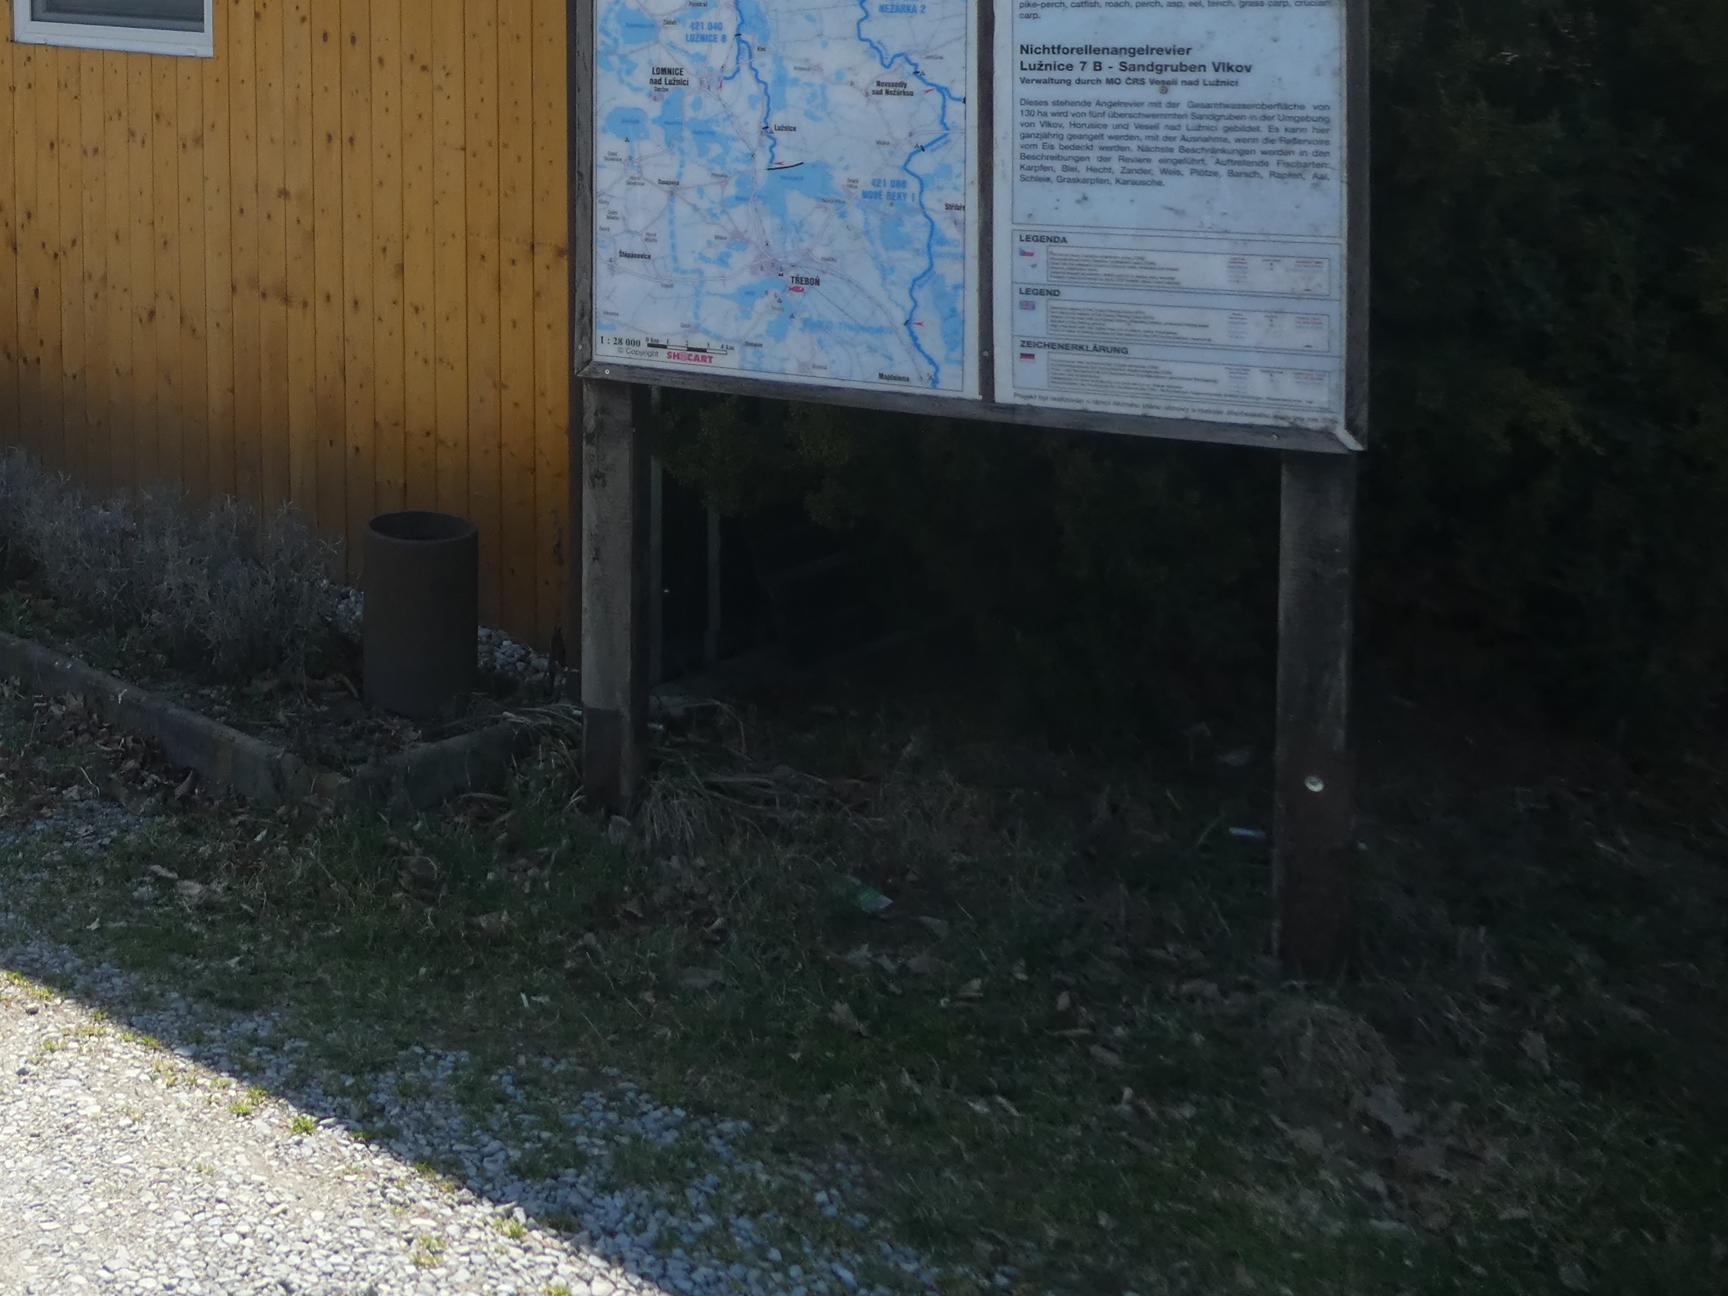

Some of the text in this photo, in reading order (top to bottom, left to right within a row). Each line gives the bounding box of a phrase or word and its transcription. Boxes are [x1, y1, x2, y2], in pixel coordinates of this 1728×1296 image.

[1020, 44, 1191, 56] Nichtforellenangelrevier
[651, 67, 684, 75] LOMNICE
[1020, 59, 1073, 71] Lužnice
[1093, 60, 1102, 71] B
[1119, 60, 1206, 74] Sandgruben
[1212, 61, 1251, 73] Vlkov
[649, 77, 661, 85] nad
[1020, 76, 1071, 85] Verwaltung
[1074, 76, 1101, 85] durch
[1106, 77, 1121, 85] MO
[1180, 78, 1199, 86] nad
[1019, 234, 1067, 244] LEGENDA
[791, 273, 819, 285] TŘEBOŇ
[1019, 287, 1060, 297] LEGEND
[612, 336, 623, 345] 28
[625, 337, 640, 347] 000
[1020, 338, 1128, 355] ZEICHENERKLÄRUNG
[625, 348, 659, 358] Copyright
